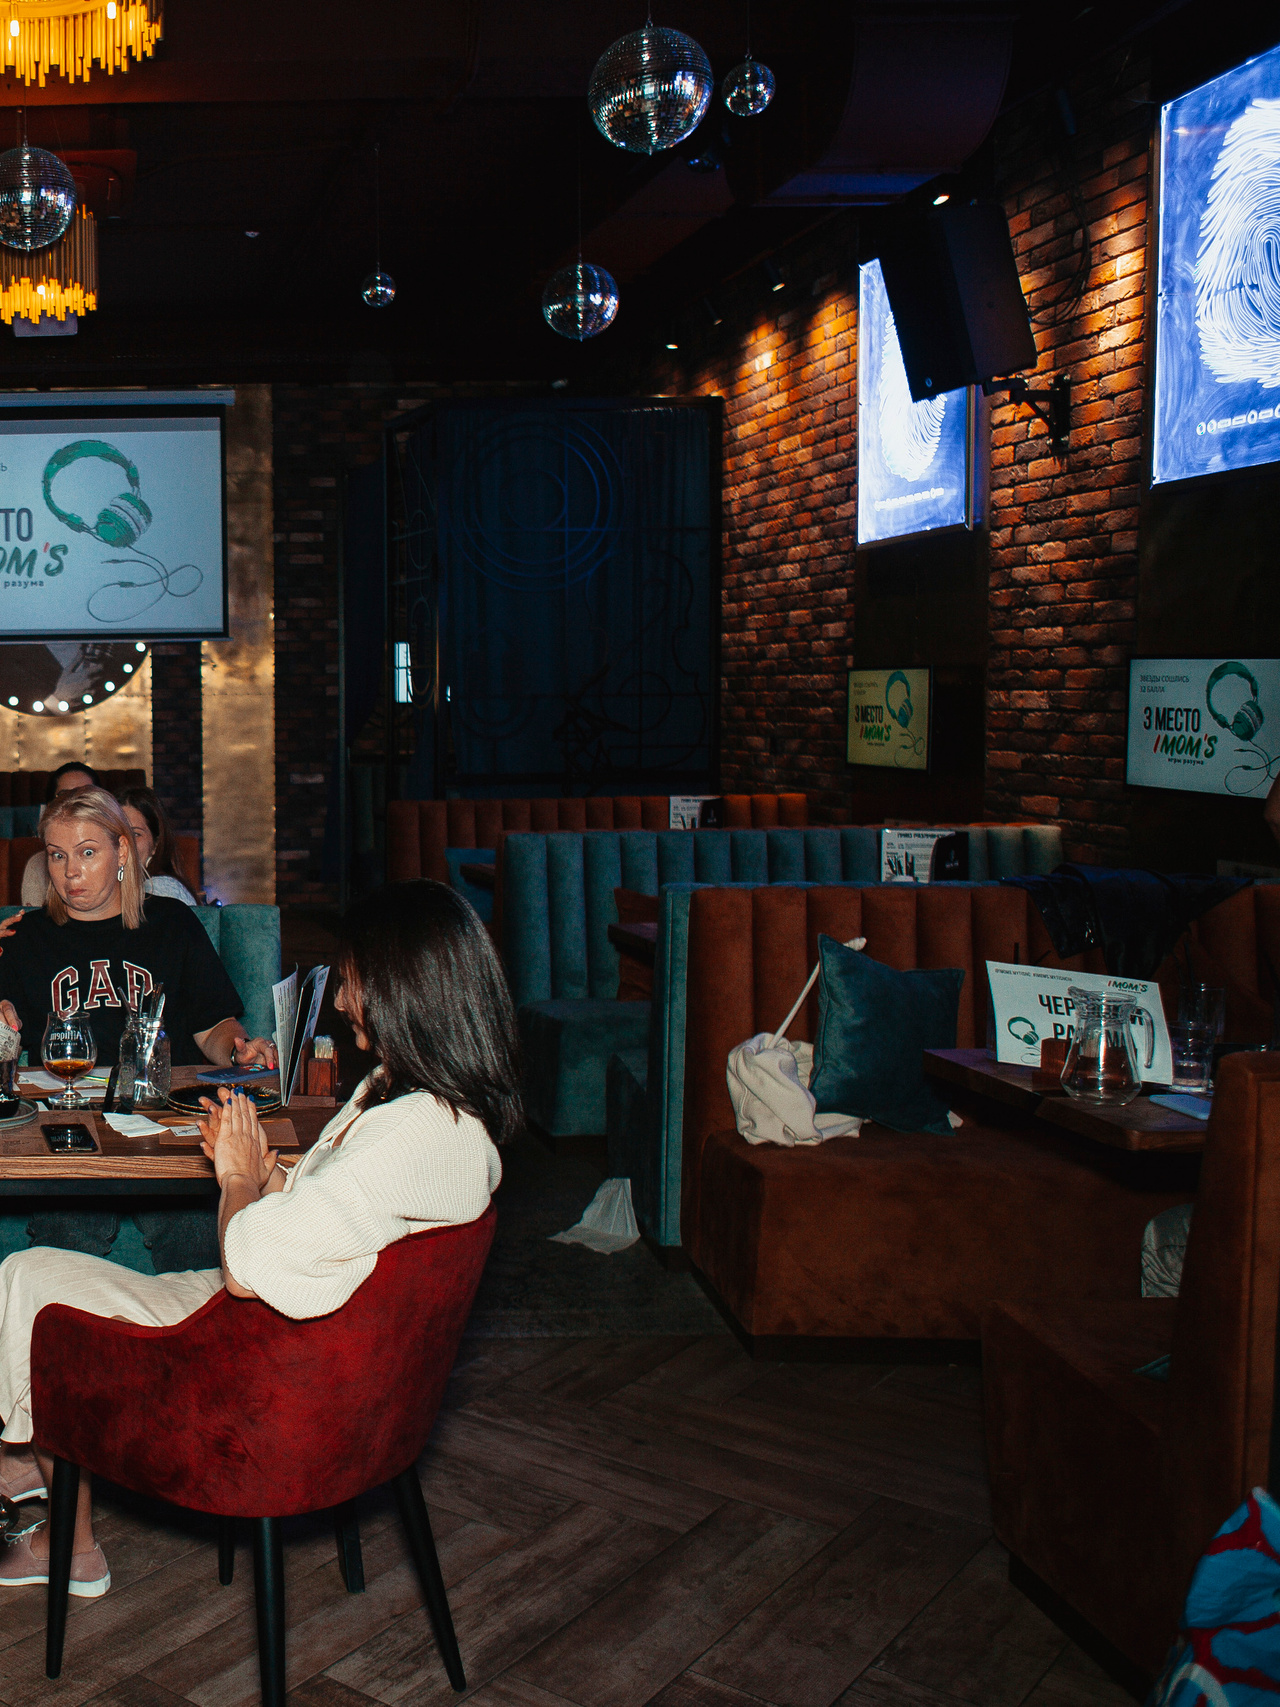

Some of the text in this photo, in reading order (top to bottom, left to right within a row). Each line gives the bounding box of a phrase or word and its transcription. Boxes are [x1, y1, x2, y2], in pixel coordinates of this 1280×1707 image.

[4, 580, 44, 589] разума
[1143, 706, 1201, 733] 3 МЕСТО
[51, 959, 153, 1021] GAP
